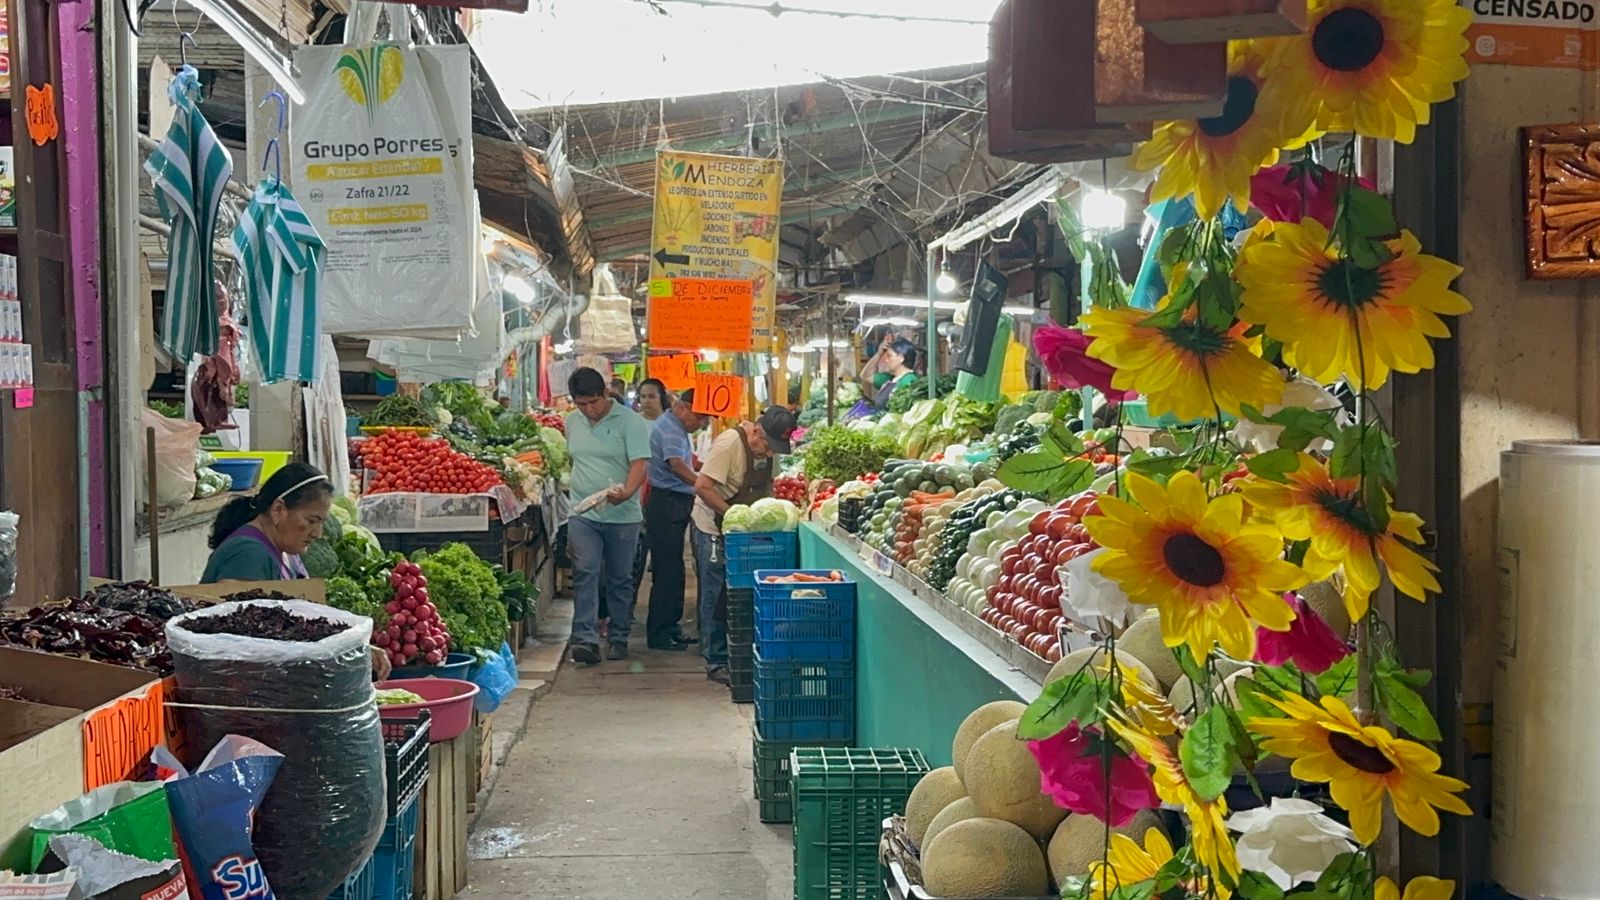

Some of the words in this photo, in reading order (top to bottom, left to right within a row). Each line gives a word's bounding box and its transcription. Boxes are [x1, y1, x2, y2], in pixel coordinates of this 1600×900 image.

[1473, 0, 1595, 23] CENSADO
[304, 140, 369, 161] Grupo
[374, 137, 444, 155] Porres
[684, 164, 764, 188] MENDOZA
[346, 187, 375, 199] Zafra
[378, 185, 410, 198] 21/22
[676, 187, 697, 197] OFRECE
[698, 188, 707, 197] UN
[708, 189, 734, 199] EXTENSO
[735, 190, 759, 201] SURTIDO
[701, 201, 735, 210] VELADORAS
[391, 207, 409, 219] 50
[412, 207, 427, 220] kg
[703, 212, 731, 222] LOCIONES
[703, 223, 729, 233] JABONES
[701, 235, 730, 245] INCIENSOS
[682, 245, 716, 255] PRODUCTOS
[716, 247, 749, 257] NATURALES
[699, 258, 720, 267] MUCHO
[674, 280, 689, 296] DE
[698, 281, 752, 295] DICIEMBRE
[701, 374, 736, 387] TOMATE
[706, 384, 730, 413] 10
[214, 857, 268, 900] Su
[147, 879, 184, 900] NUEVA
